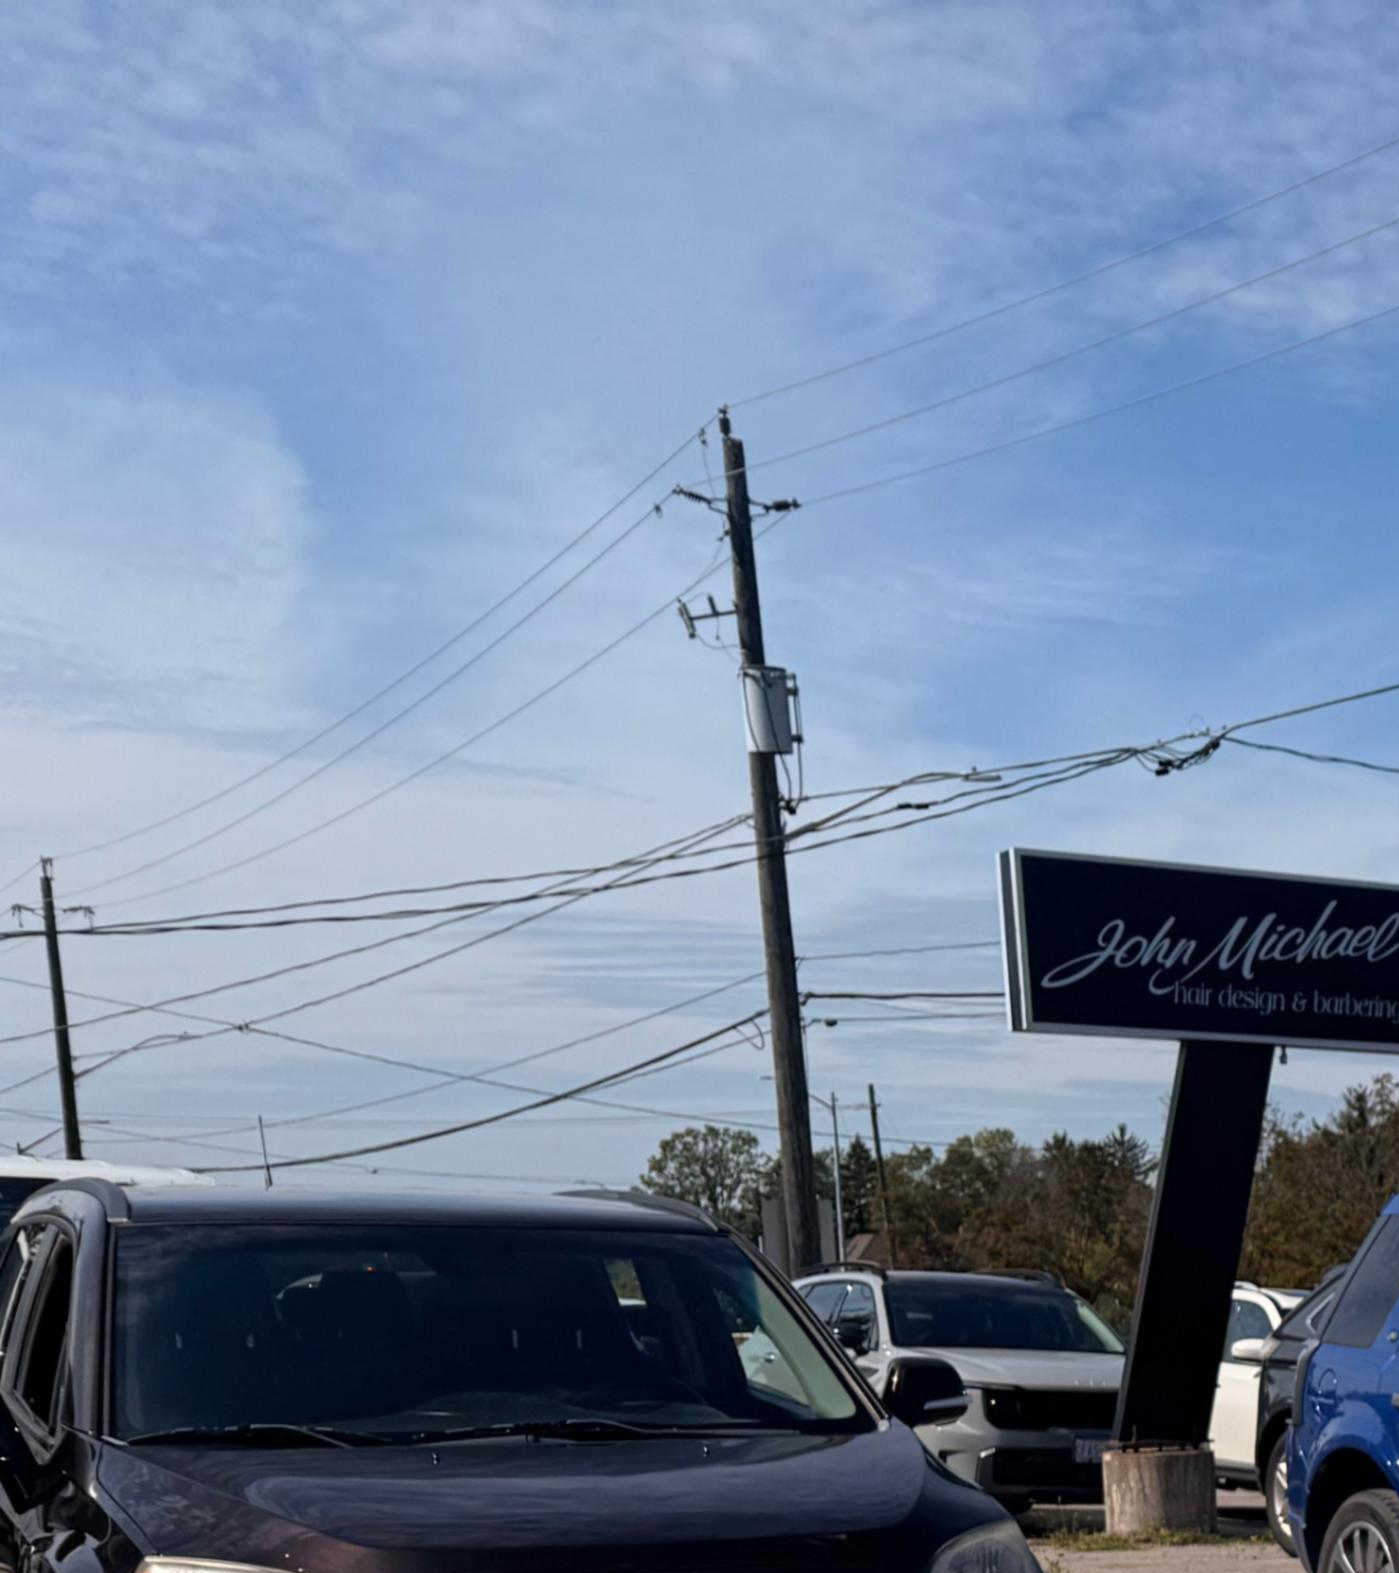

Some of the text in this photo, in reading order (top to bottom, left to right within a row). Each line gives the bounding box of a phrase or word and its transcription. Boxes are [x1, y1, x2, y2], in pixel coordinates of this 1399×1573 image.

[1041, 916, 1198, 996] John
[1174, 980, 1213, 1007] hair
[1218, 984, 1285, 1016] design
[1291, 992, 1308, 1012] &
